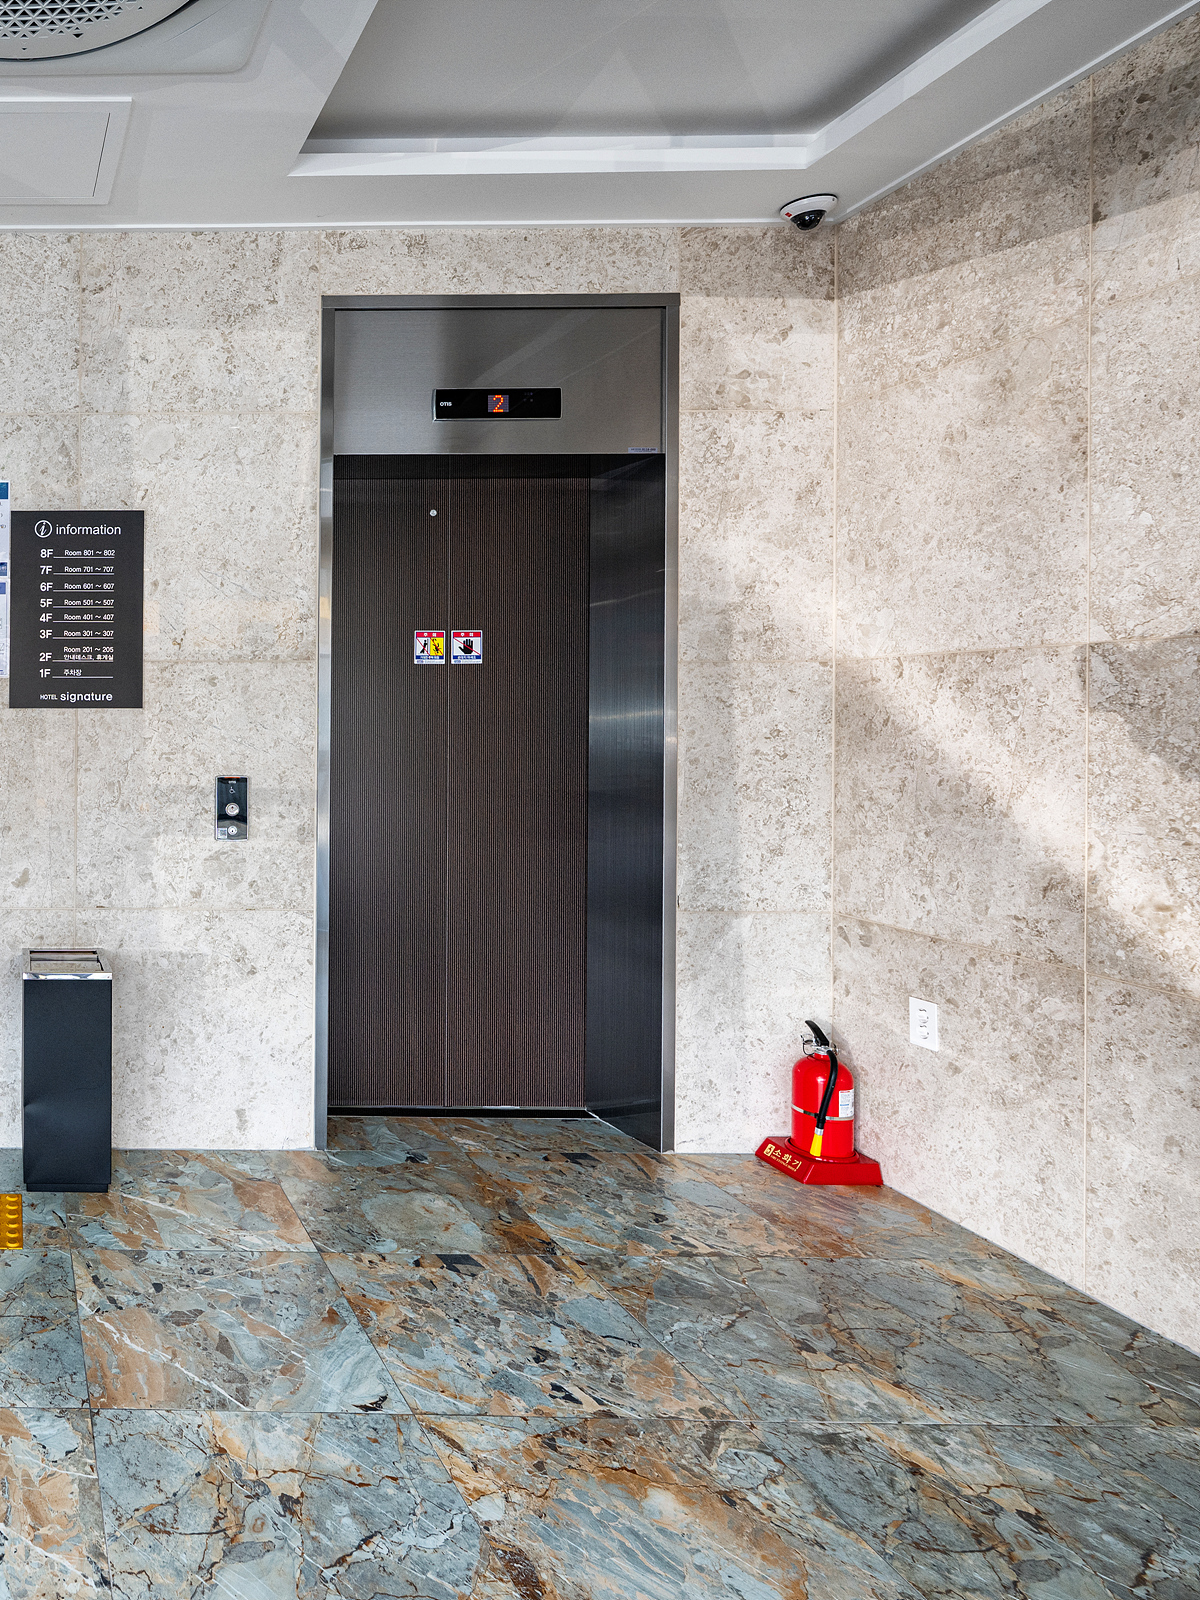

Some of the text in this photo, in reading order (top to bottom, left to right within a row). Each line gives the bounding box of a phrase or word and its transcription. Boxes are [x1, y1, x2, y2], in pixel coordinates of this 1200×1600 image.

[493, 394, 504, 412] 2
[56, 524, 121, 535] information
[40, 549, 54, 558] 8F
[40, 566, 53, 575] 7F
[40, 582, 53, 592] 6F
[39, 599, 53, 608] 5F
[39, 613, 53, 623] 4F
[39, 629, 53, 639] 3F
[39, 652, 52, 662] 2F
[40, 669, 51, 678] 1F
[60, 692, 113, 703] signature
[772, 1150, 802, 1170] 소화기
